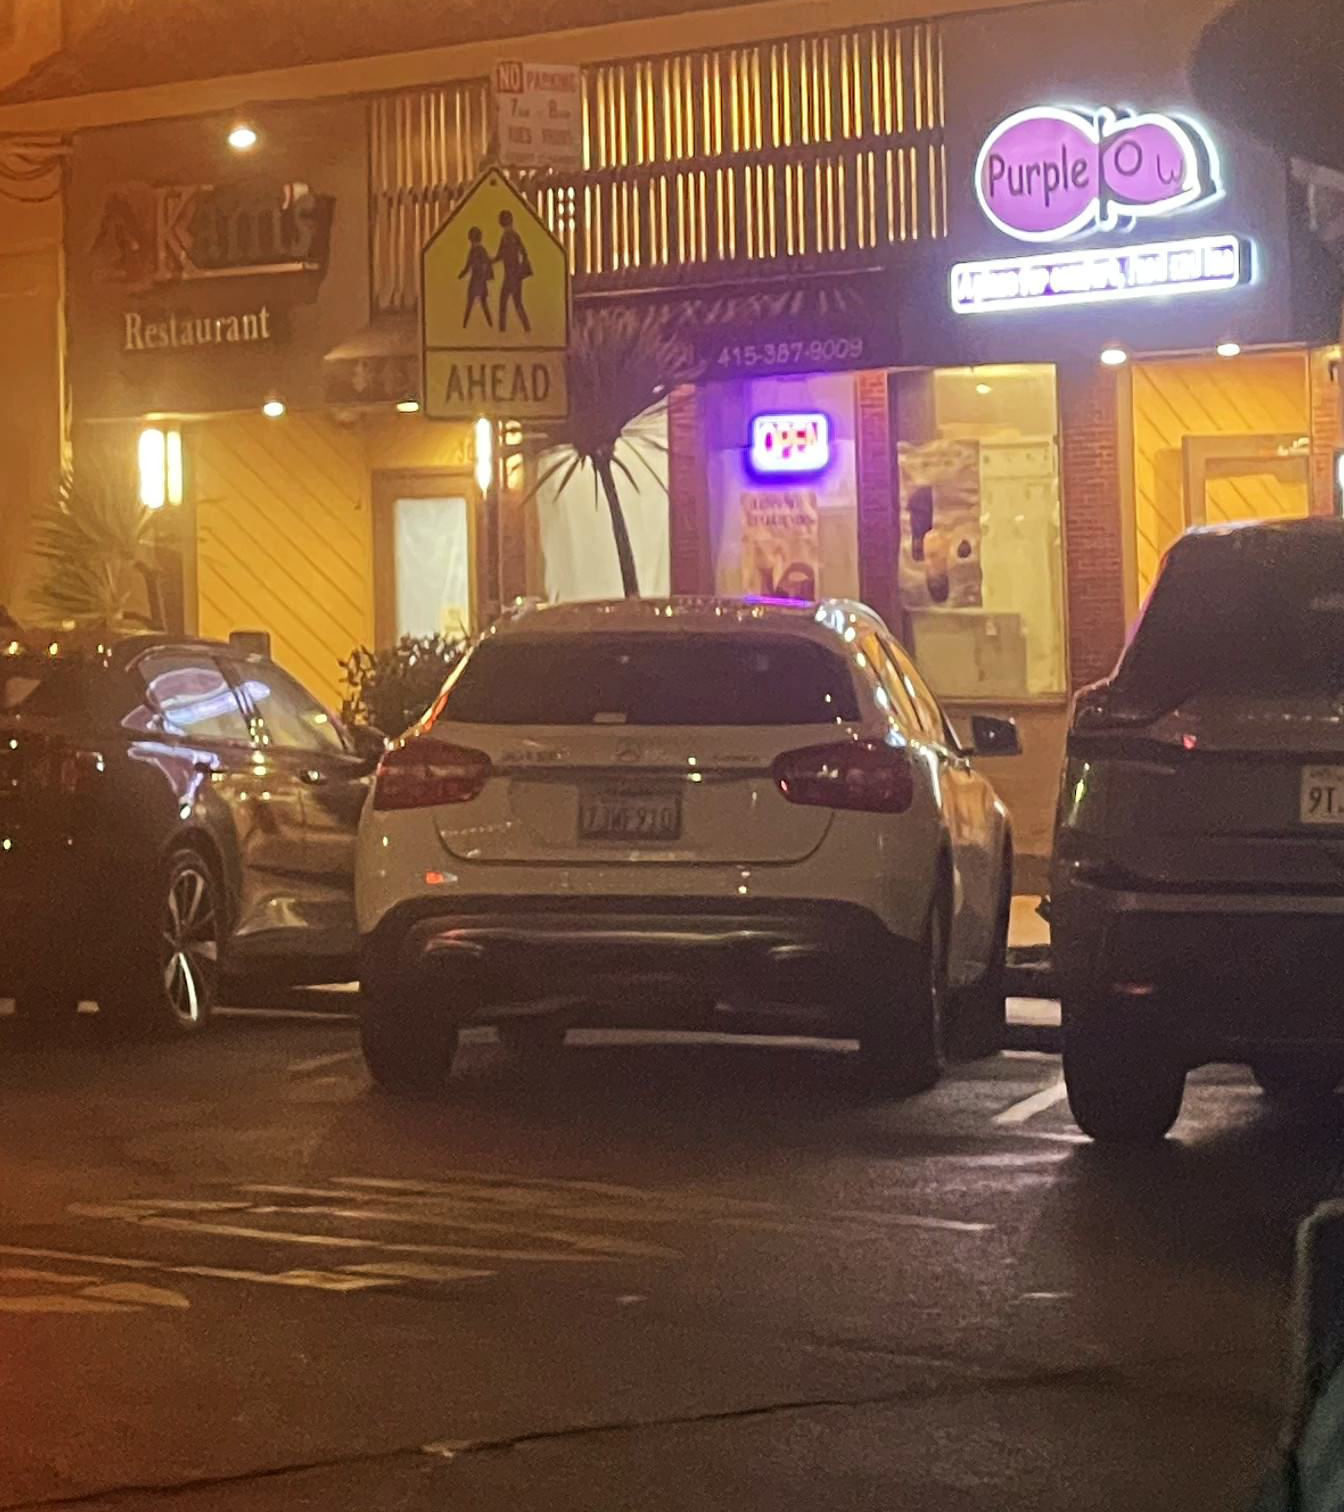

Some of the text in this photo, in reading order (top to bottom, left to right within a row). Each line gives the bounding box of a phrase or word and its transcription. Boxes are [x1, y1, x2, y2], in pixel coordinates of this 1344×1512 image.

[499, 63, 521, 92] NO
[989, 143, 1089, 208] Purple
[124, 305, 271, 350] Restaurant
[444, 363, 550, 403] AHEAD
[758, 422, 820, 461] OPEN
